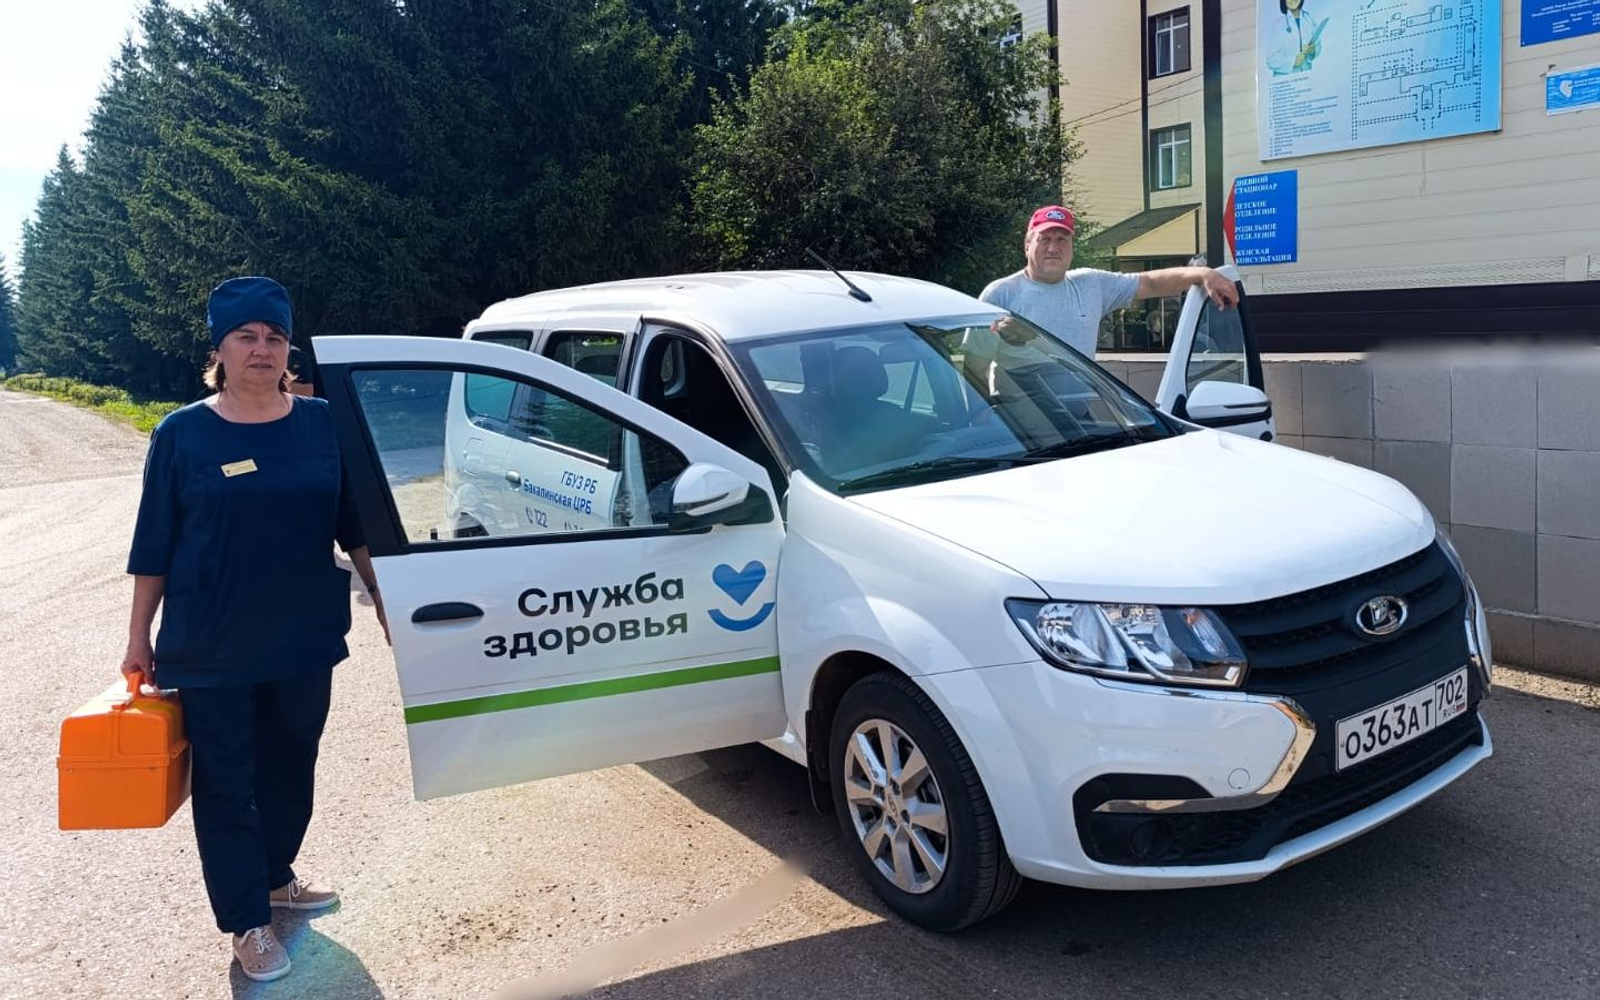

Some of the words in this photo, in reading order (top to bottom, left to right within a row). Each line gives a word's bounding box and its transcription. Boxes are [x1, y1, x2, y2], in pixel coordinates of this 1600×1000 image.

[1236, 176, 1268, 187] ДНЕВНОЙ
[1235, 184, 1278, 194] СТАЦИОНАР
[1235, 201, 1267, 210] ДЕТСКОЕ
[1235, 208, 1277, 217] ОТДЕЛЕНИЕ
[1235, 223, 1277, 232] РОДИЛЬНОЕ
[1235, 231, 1277, 240] ОТДЕЛЕНИЕ
[1236, 248, 1270, 256] ЖЕНСКАЯ
[1236, 254, 1292, 264] КОНСУЛЬТАЦИЯ
[561, 471, 584, 490] ГБУЗ
[583, 478, 598, 494] РБ
[523, 479, 572, 509] Бакалинская
[573, 496, 592, 515] ЦРБ
[517, 572, 684, 618] Служба
[483, 612, 688, 659] здоровья
[1437, 674, 1463, 711] 702
